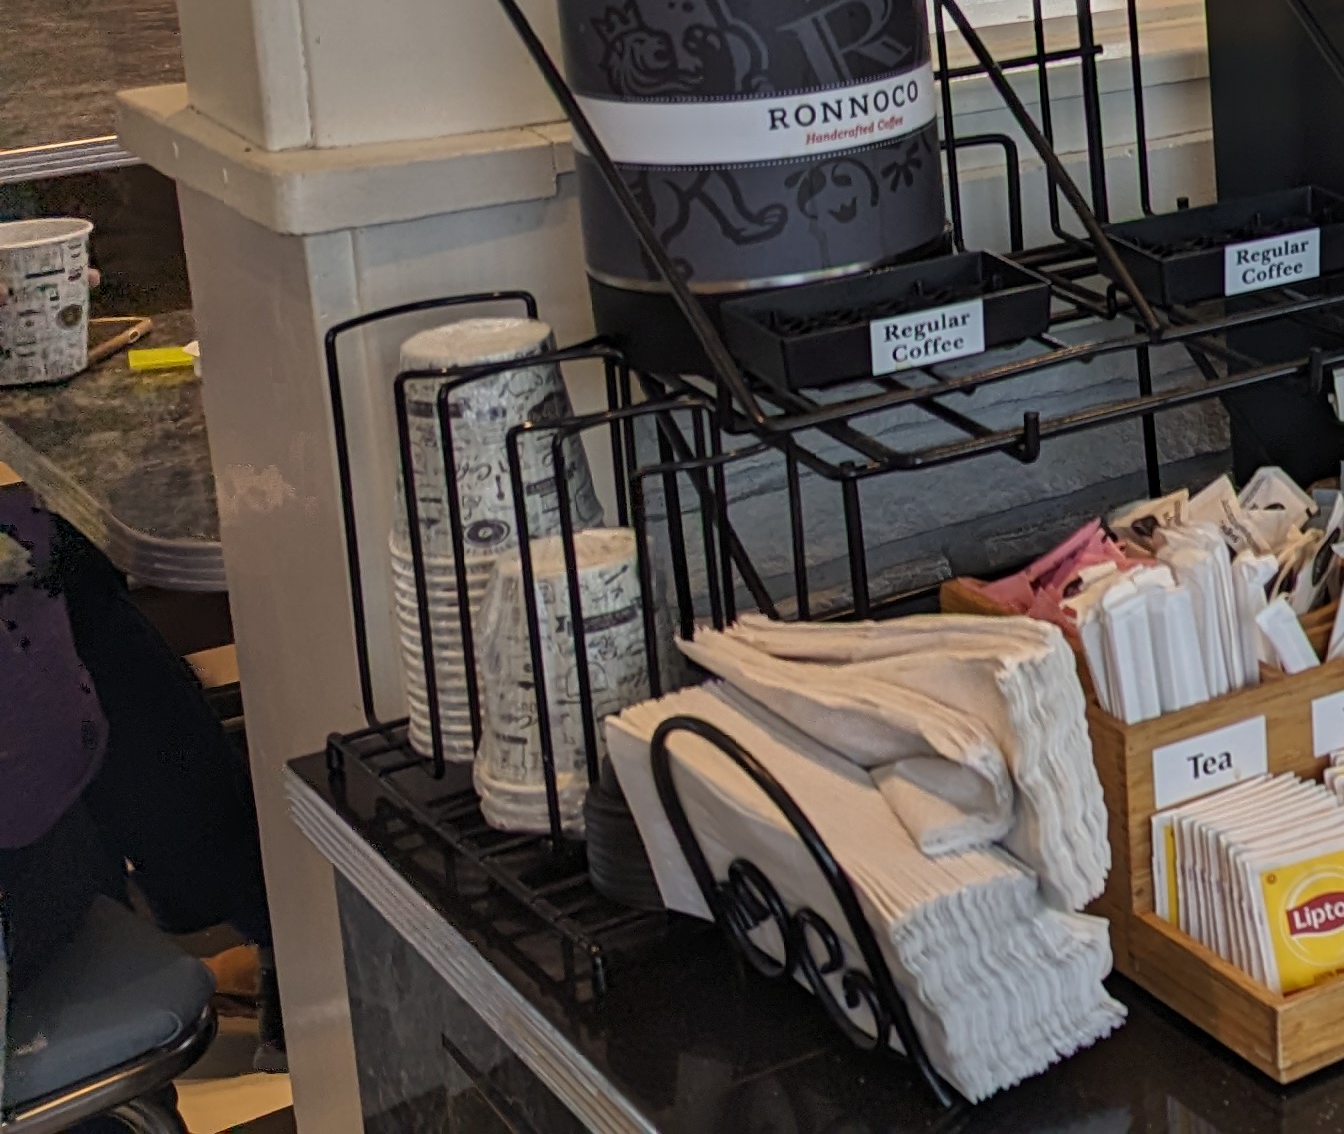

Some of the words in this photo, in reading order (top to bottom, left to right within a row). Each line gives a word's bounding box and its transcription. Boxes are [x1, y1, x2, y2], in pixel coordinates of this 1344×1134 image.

[768, 79, 919, 131] RONNOCO
[805, 120, 875, 146] Handcrafted
[877, 116, 904, 132] Coffee
[1235, 239, 1310, 267] Regular
[1241, 260, 1304, 286] Coffee
[883, 308, 971, 344] Regular
[891, 335, 965, 364] Coffee
[1187, 748, 1234, 781] Tea
